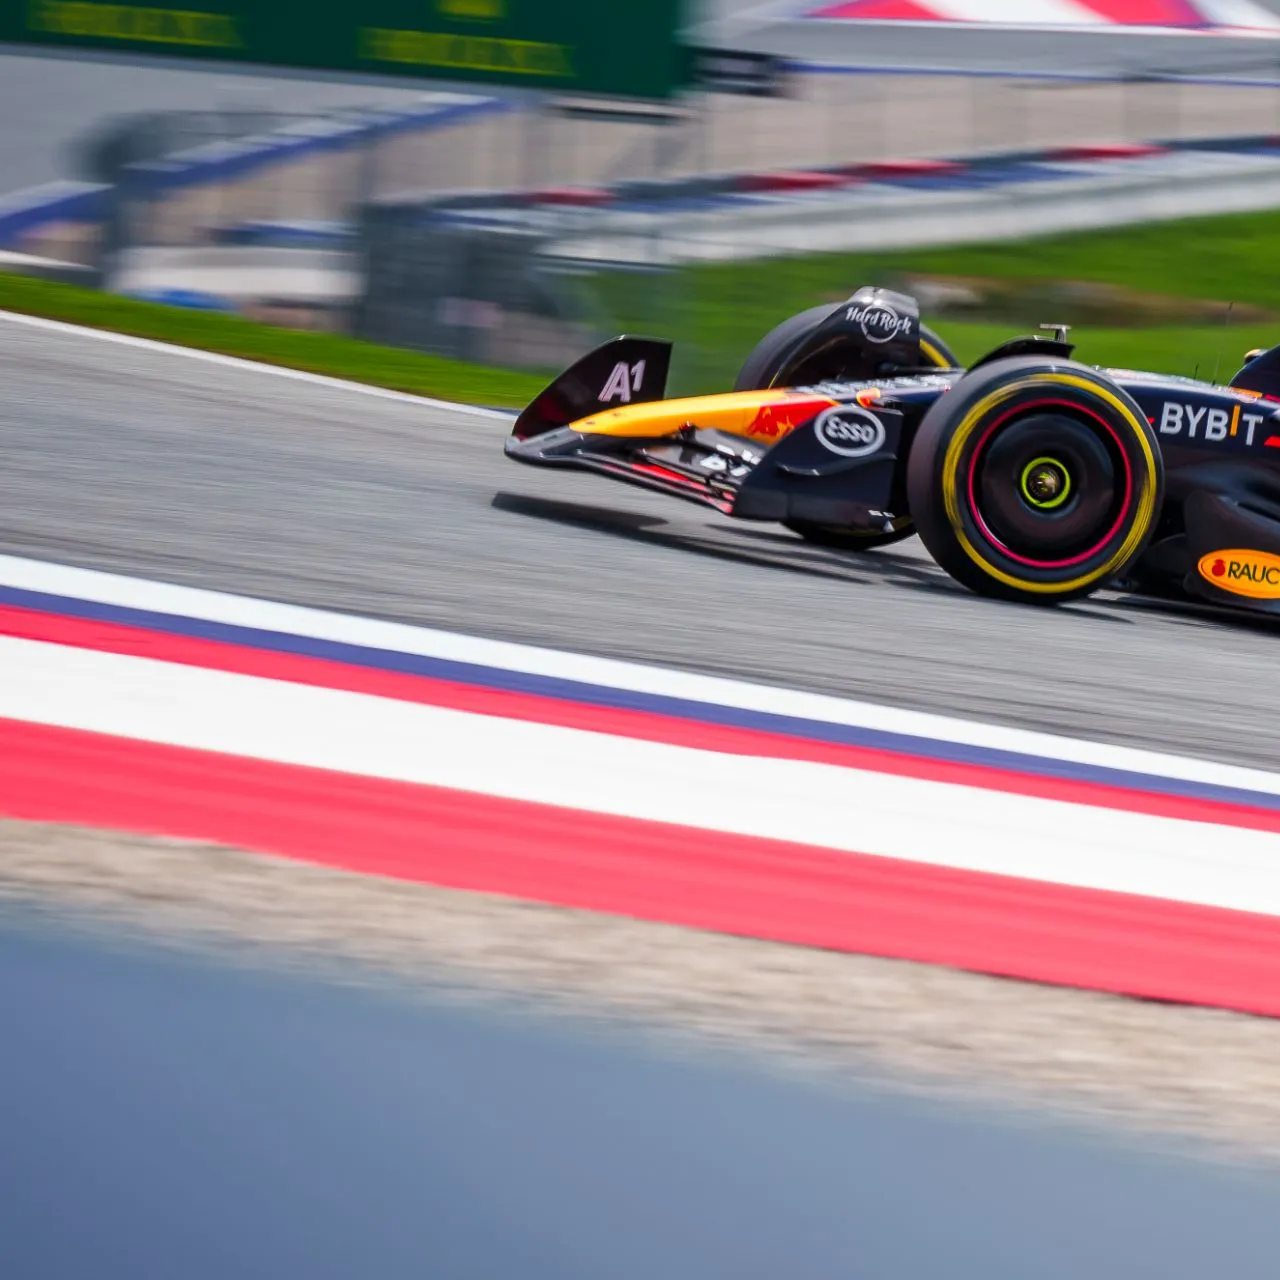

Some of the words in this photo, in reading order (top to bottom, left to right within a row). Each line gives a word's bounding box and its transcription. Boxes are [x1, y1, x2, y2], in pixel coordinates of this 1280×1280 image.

[845, 307, 881, 326] Hard
[879, 312, 912, 335] Rock
[597, 359, 647, 402] A1
[1160, 401, 1264, 446] BYBIT
